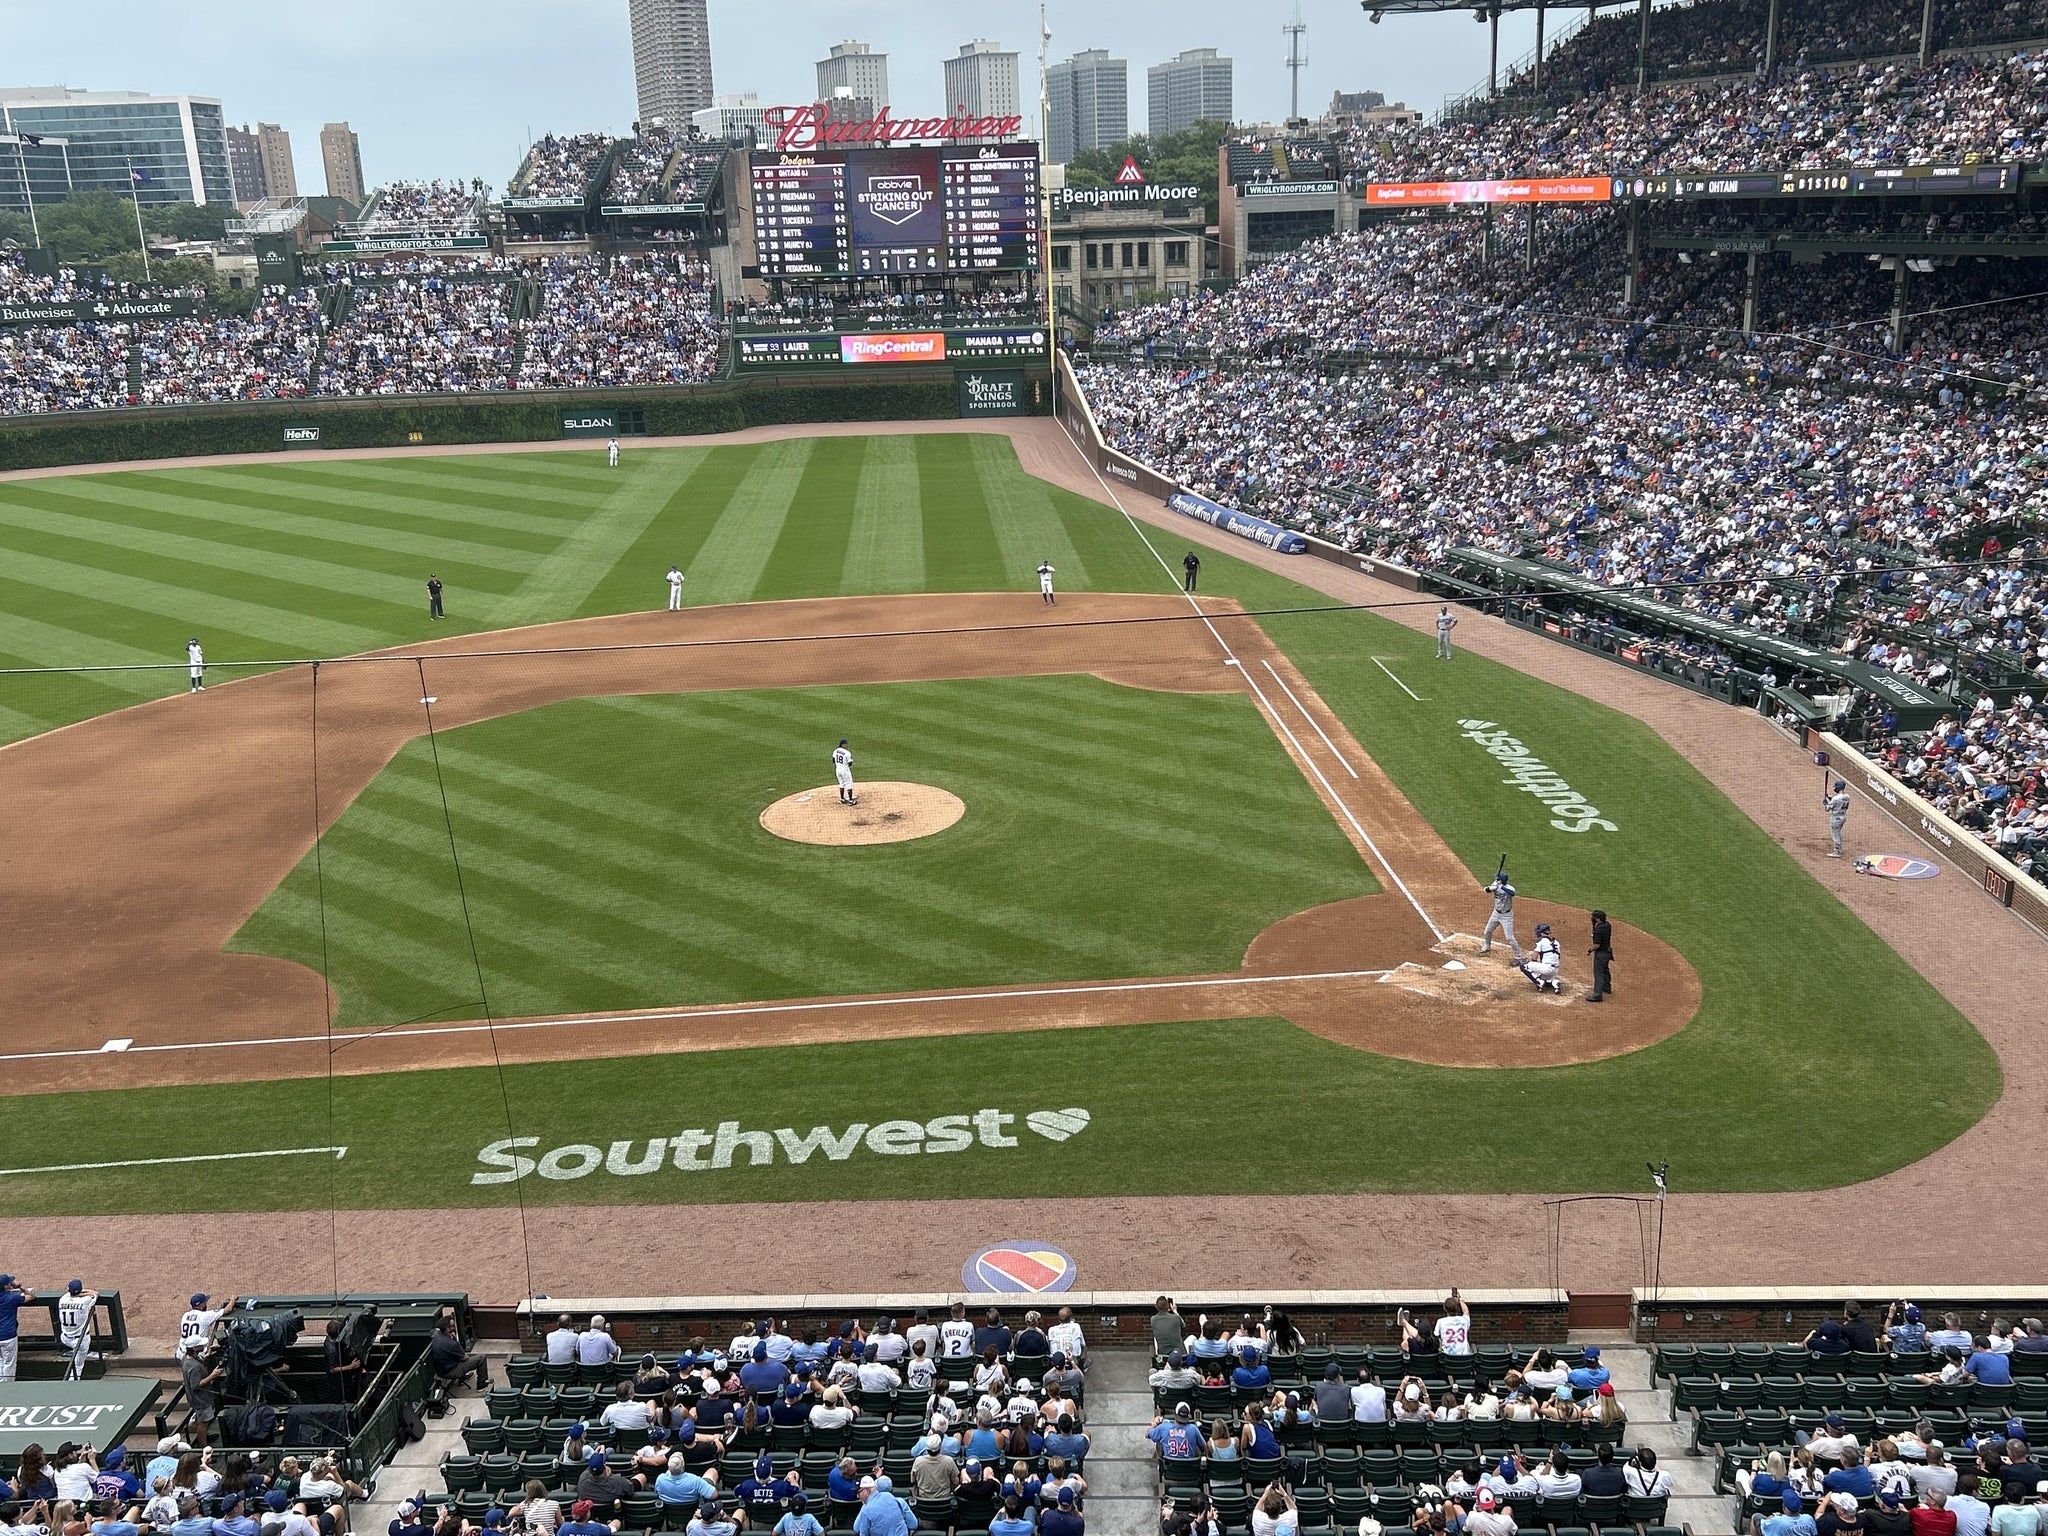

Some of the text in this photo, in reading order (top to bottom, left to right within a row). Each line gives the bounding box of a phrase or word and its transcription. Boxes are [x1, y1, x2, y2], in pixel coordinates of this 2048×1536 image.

[764, 104, 1022, 149] Budweiser
[979, 148, 999, 158] Cubs
[779, 154, 816, 168] Dodgers
[970, 174, 992, 182] SUZUKI
[878, 181, 912, 189] abbvie
[1250, 183, 1334, 194] WRIGLEYROOFTOPS.COM
[1626, 183, 1631, 194] 1
[1647, 182, 1652, 193] 6
[1708, 180, 1738, 192] OHTANI
[1808, 178, 1812, 190] 1
[1824, 177, 1829, 190] 1
[970, 186, 1000, 194] BREGMAN
[780, 192, 807, 200] FREEMAN
[858, 191, 933, 202] STRIKING OUT
[1063, 185, 1198, 206] Benjamin Moore
[874, 202, 918, 210] CANCER
[971, 198, 990, 206] KELLY
[781, 204, 802, 212] EDMAN
[972, 210, 992, 218] BUSCH
[782, 216, 805, 224] TUCKER
[972, 222, 1000, 230] HOERNER
[972, 235, 989, 243] HAPP
[354, 240, 454, 250] WRIGLEYROOFTOPS.COM
[784, 241, 804, 249] MUNCY
[974, 247, 1002, 256] SWANSON
[784, 253, 804, 261] ROJAS
[786, 264, 814, 272] FEDUCCIA
[862, 256, 936, 270] 3 1 2 4
[974, 259, 996, 267] TAYLOR
[113, 302, 171, 314] Advocate
[2, 308, 73, 320] Budweiser
[966, 336, 1003, 346] IMANAGA
[783, 342, 809, 352] LAUER
[852, 340, 934, 356] RingCentral
[968, 383, 1013, 394] DRAFT
[974, 392, 1012, 400] KINGS
[564, 418, 612, 428] SLOAN
[286, 430, 317, 440] Hefty
[1172, 496, 1210, 522] Reynolds Wrap
[1228, 517, 1256, 539] Reynolds
[1255, 526, 1274, 548] Wrap
[1460, 730, 1618, 832] Southwest
[1927, 822, 1952, 848] Advocate
[470, 1108, 1018, 1184] Southwest
[62, 1312, 77, 1327] 11
[182, 1323, 200, 1338] 90
[1445, 1328, 1466, 1344] 23
[952, 1340, 962, 1355] 2
[736, 1350, 750, 1360] 24
[918, 1374, 924, 1384] 7
[1168, 1440, 1190, 1456] 34
[754, 1489, 774, 1498] BETTS
